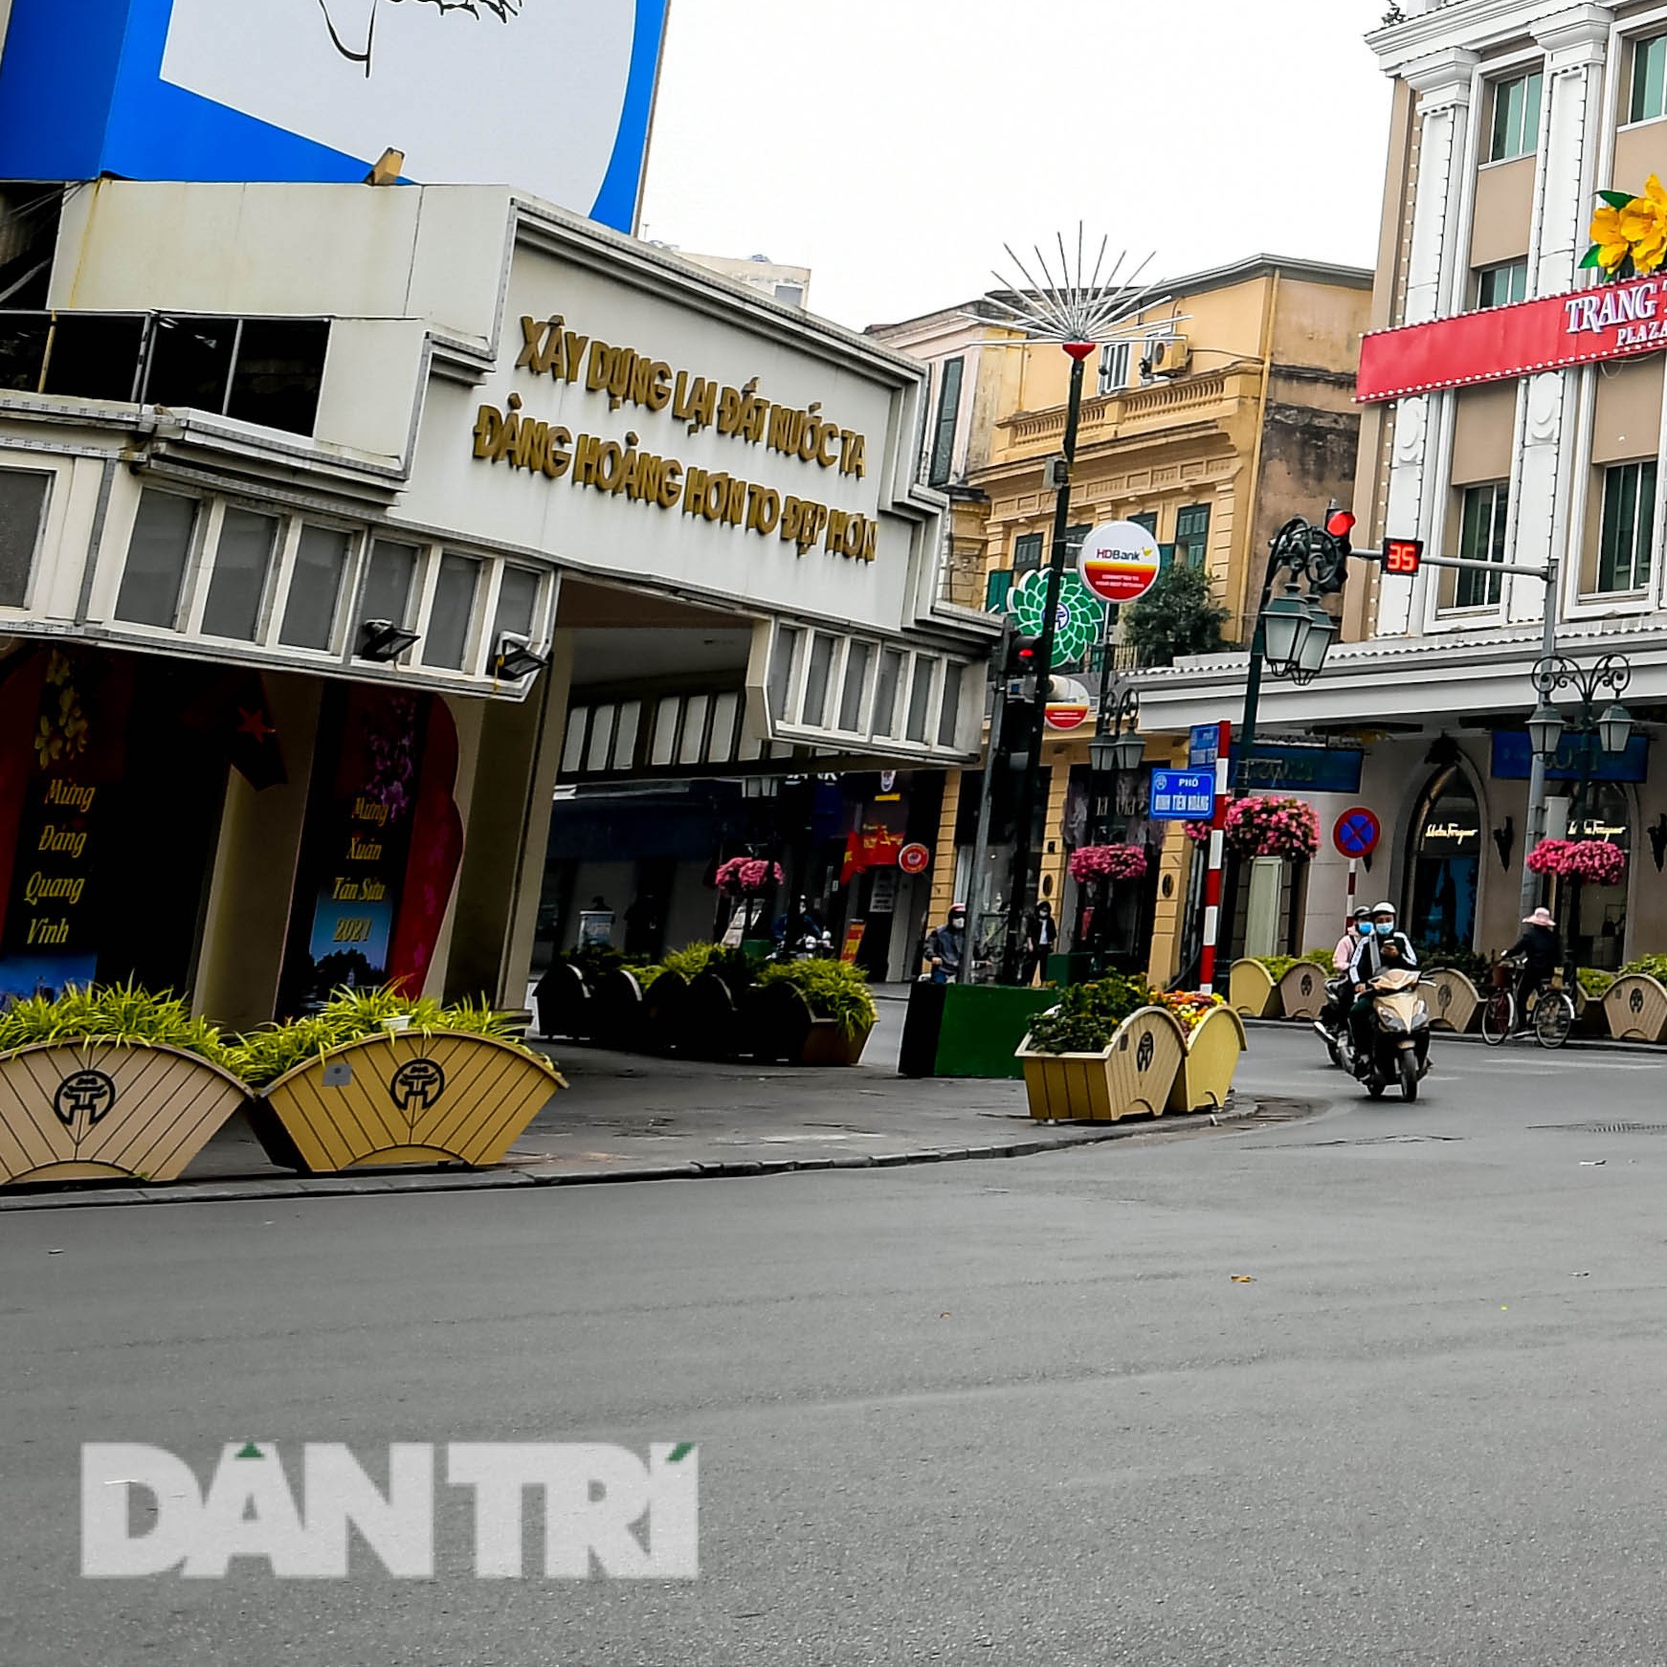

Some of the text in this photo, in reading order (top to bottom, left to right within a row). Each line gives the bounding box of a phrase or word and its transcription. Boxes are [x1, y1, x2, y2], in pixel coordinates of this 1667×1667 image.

[1565, 283, 1658, 333] TRANG
[515, 315, 589, 383] XÂY
[672, 371, 719, 436] LẠI
[717, 377, 770, 445] ĐẤT
[840, 430, 867, 479] TA
[746, 483, 780, 535] TO
[781, 495, 828, 556] ĐẸP
[1096, 548, 1140, 561] HDBank
[1387, 543, 1415, 571] 35
[44, 777, 96, 813] Mừng
[24, 871, 85, 905] Quang
[27, 917, 69, 944] Vinh
